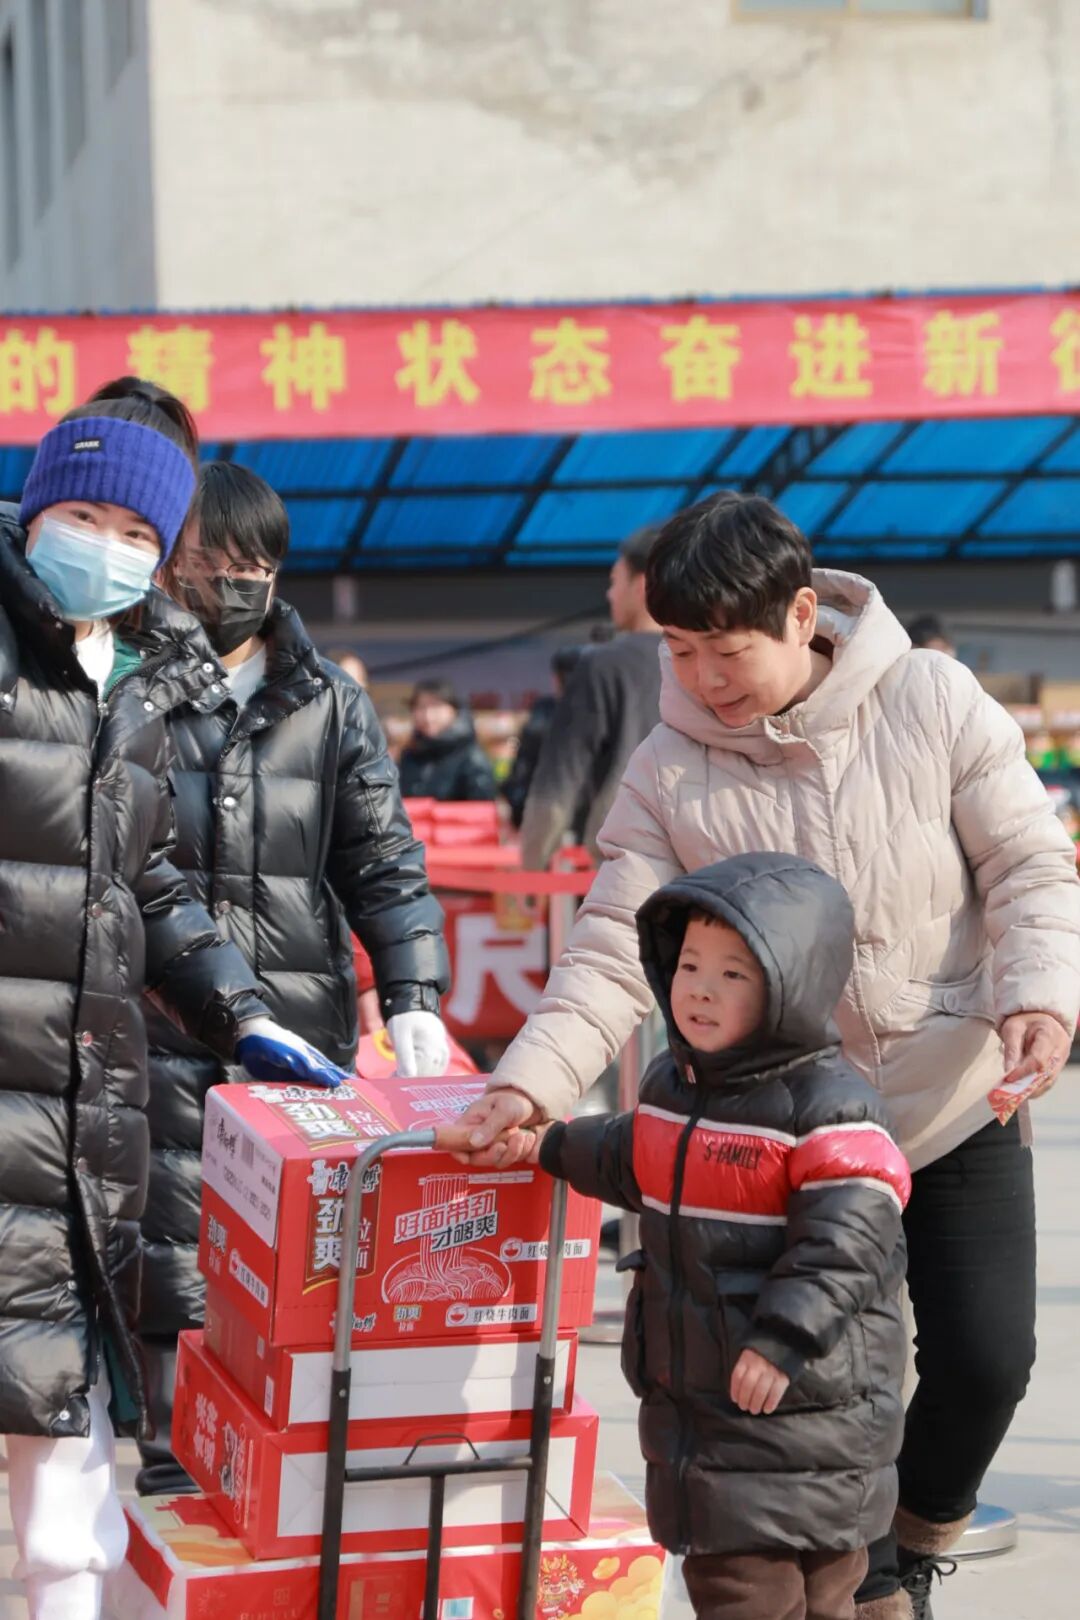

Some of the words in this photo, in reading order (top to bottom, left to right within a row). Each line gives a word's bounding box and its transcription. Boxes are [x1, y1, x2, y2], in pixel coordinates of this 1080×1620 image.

[396, 1191, 496, 1239] 好面带劲
[432, 1214, 496, 1250] 才够爽
[527, 1243, 584, 1258] 红烧肉面
[473, 1306, 530, 1323] 红烧牛肉面
